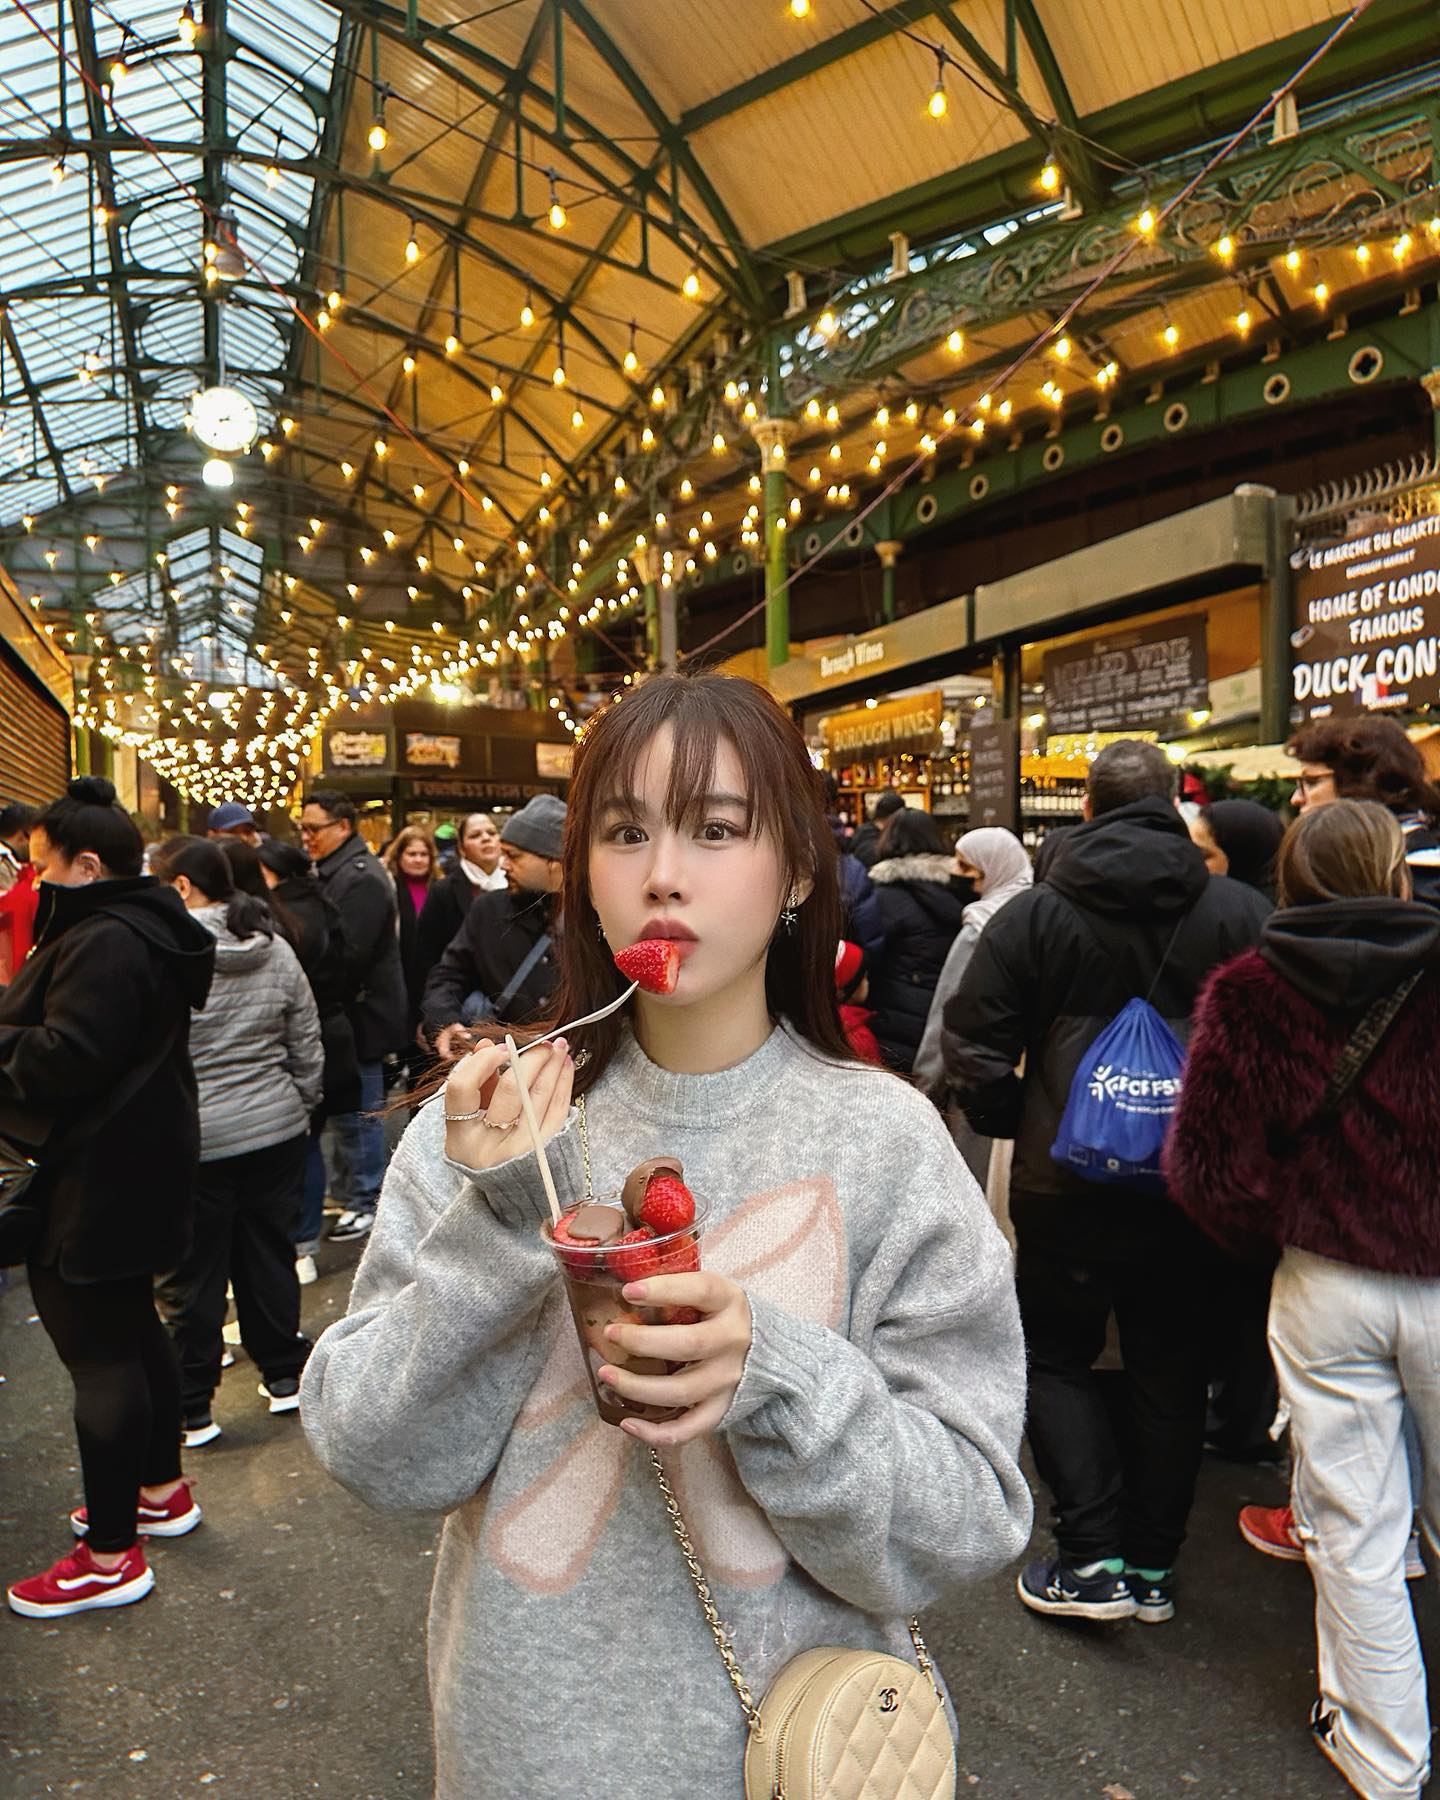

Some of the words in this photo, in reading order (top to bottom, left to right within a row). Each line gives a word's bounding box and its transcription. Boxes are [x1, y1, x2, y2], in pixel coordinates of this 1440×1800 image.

[1309, 550, 1323, 570] LE
[1373, 531, 1392, 552] DU
[1309, 591, 1358, 623] HOME
[1360, 582, 1386, 613] OF
[1348, 605, 1425, 645] FAMOUS
[1293, 654, 1369, 700] DUCK
[1376, 637, 1440, 685] CON
[891, 709, 935, 740] WINES
